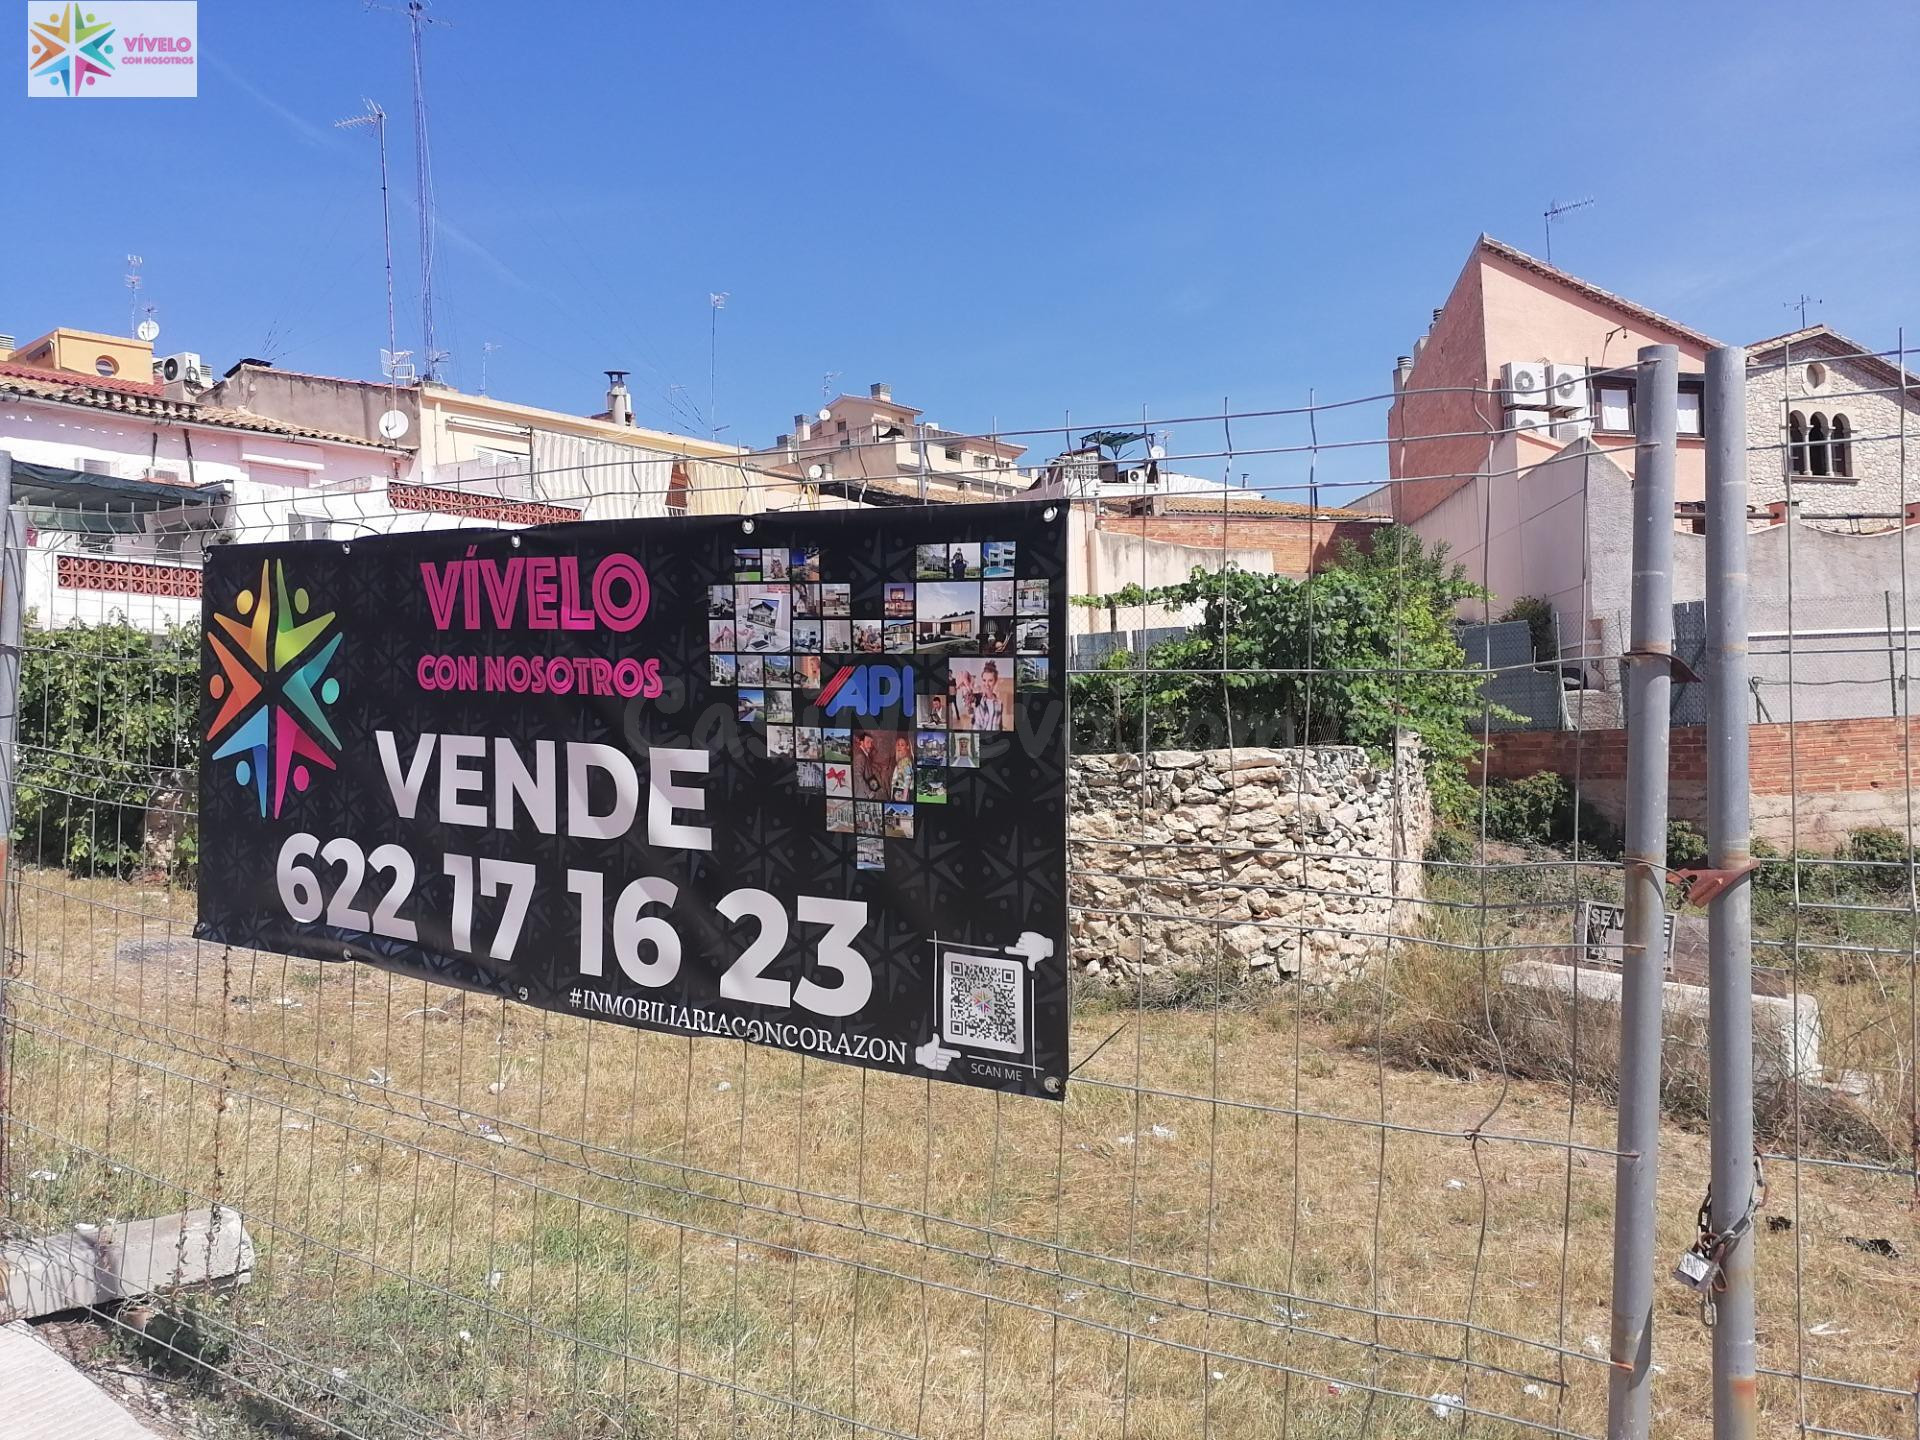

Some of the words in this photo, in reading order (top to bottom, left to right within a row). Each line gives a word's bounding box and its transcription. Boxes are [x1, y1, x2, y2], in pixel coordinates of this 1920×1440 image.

[420, 545, 650, 632] VÍVELO
[417, 655, 477, 692] CON
[485, 656, 664, 699] NOSOTROS
[825, 664, 914, 718] API
[375, 730, 713, 851] VENDE
[276, 832, 419, 942] 622
[444, 853, 536, 961] 17
[567, 868, 682, 988] 16
[715, 888, 873, 1016] 23
[1591, 908, 1610, 926] SE
[569, 987, 907, 1065] #INMOBILIARIACONCORAZON
[971, 1062, 1001, 1078] SCAN
[1004, 1068, 1023, 1081] ME
